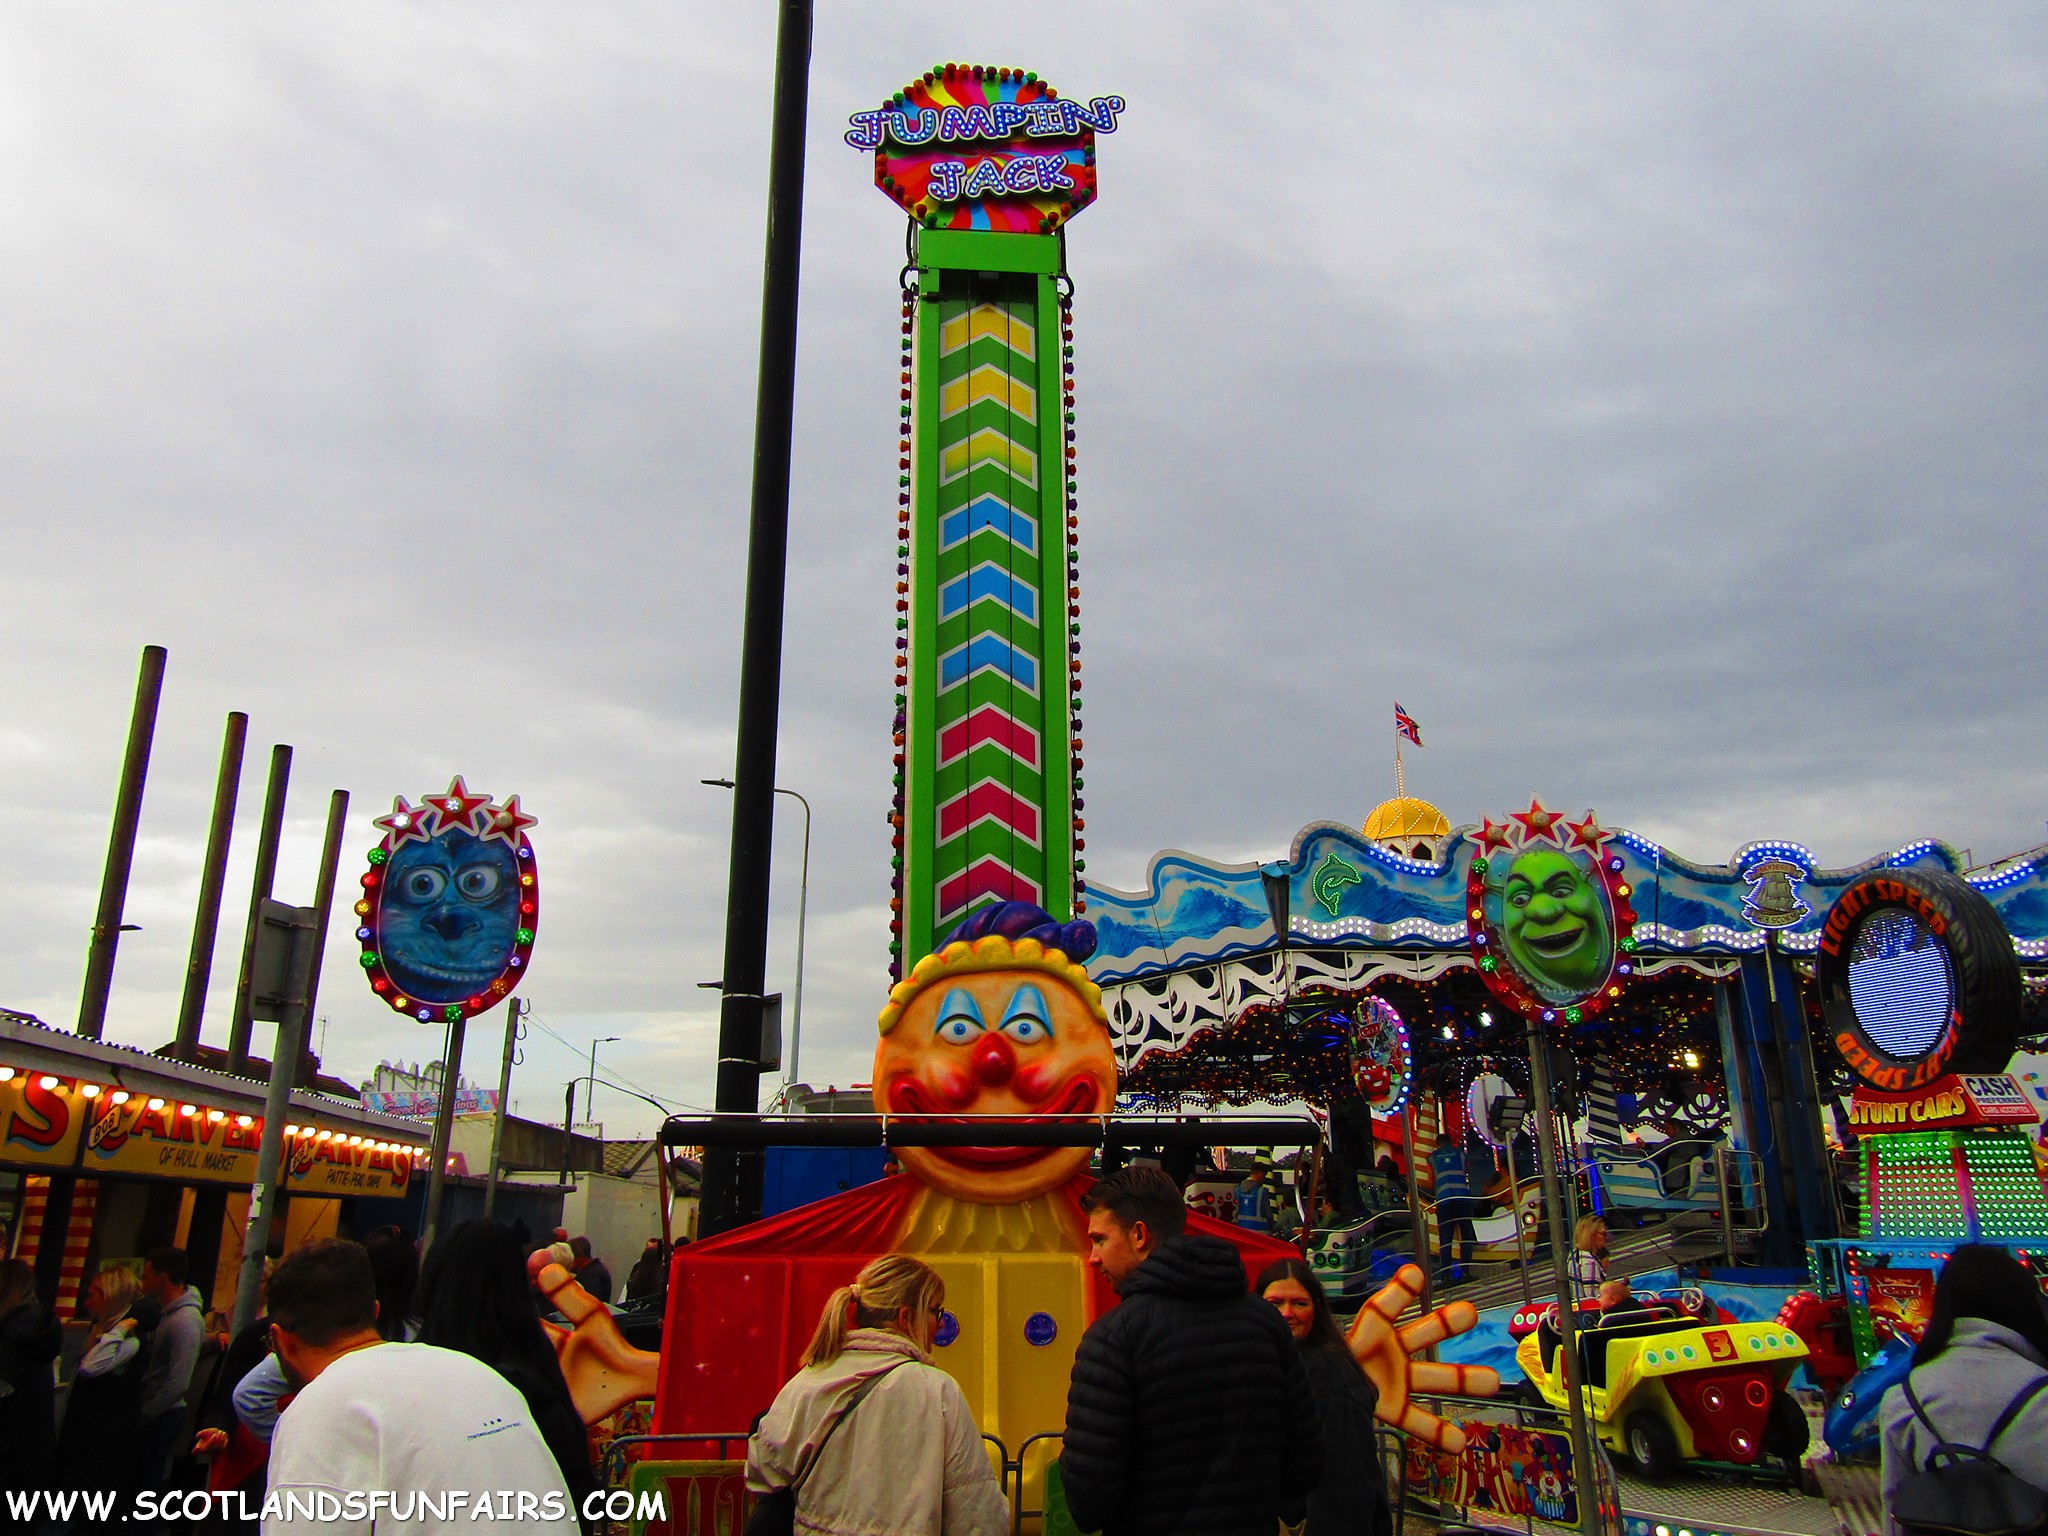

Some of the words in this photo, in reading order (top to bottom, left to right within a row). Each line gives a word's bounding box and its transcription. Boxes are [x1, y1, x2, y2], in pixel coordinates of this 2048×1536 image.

[927, 154, 1075, 202] JACK
[1820, 882, 1871, 957] LIGHT
[1874, 878, 1947, 936] SPEED
[1835, 1032, 1908, 1090] SPEED
[1965, 1076, 2019, 1097] CASH
[1974, 1097, 2025, 1105] PREFERRED
[96, 1086, 284, 1160] CARVER
[1849, 1101, 1908, 1125] STUNT
[1910, 1086, 1967, 1122] CARS
[92, 1112, 116, 1144] BOB
[159, 1147, 175, 1167] OF
[174, 1148, 198, 1169] HULL
[202, 1152, 239, 1172] MARKET
[1708, 1332, 1731, 1358] 3
